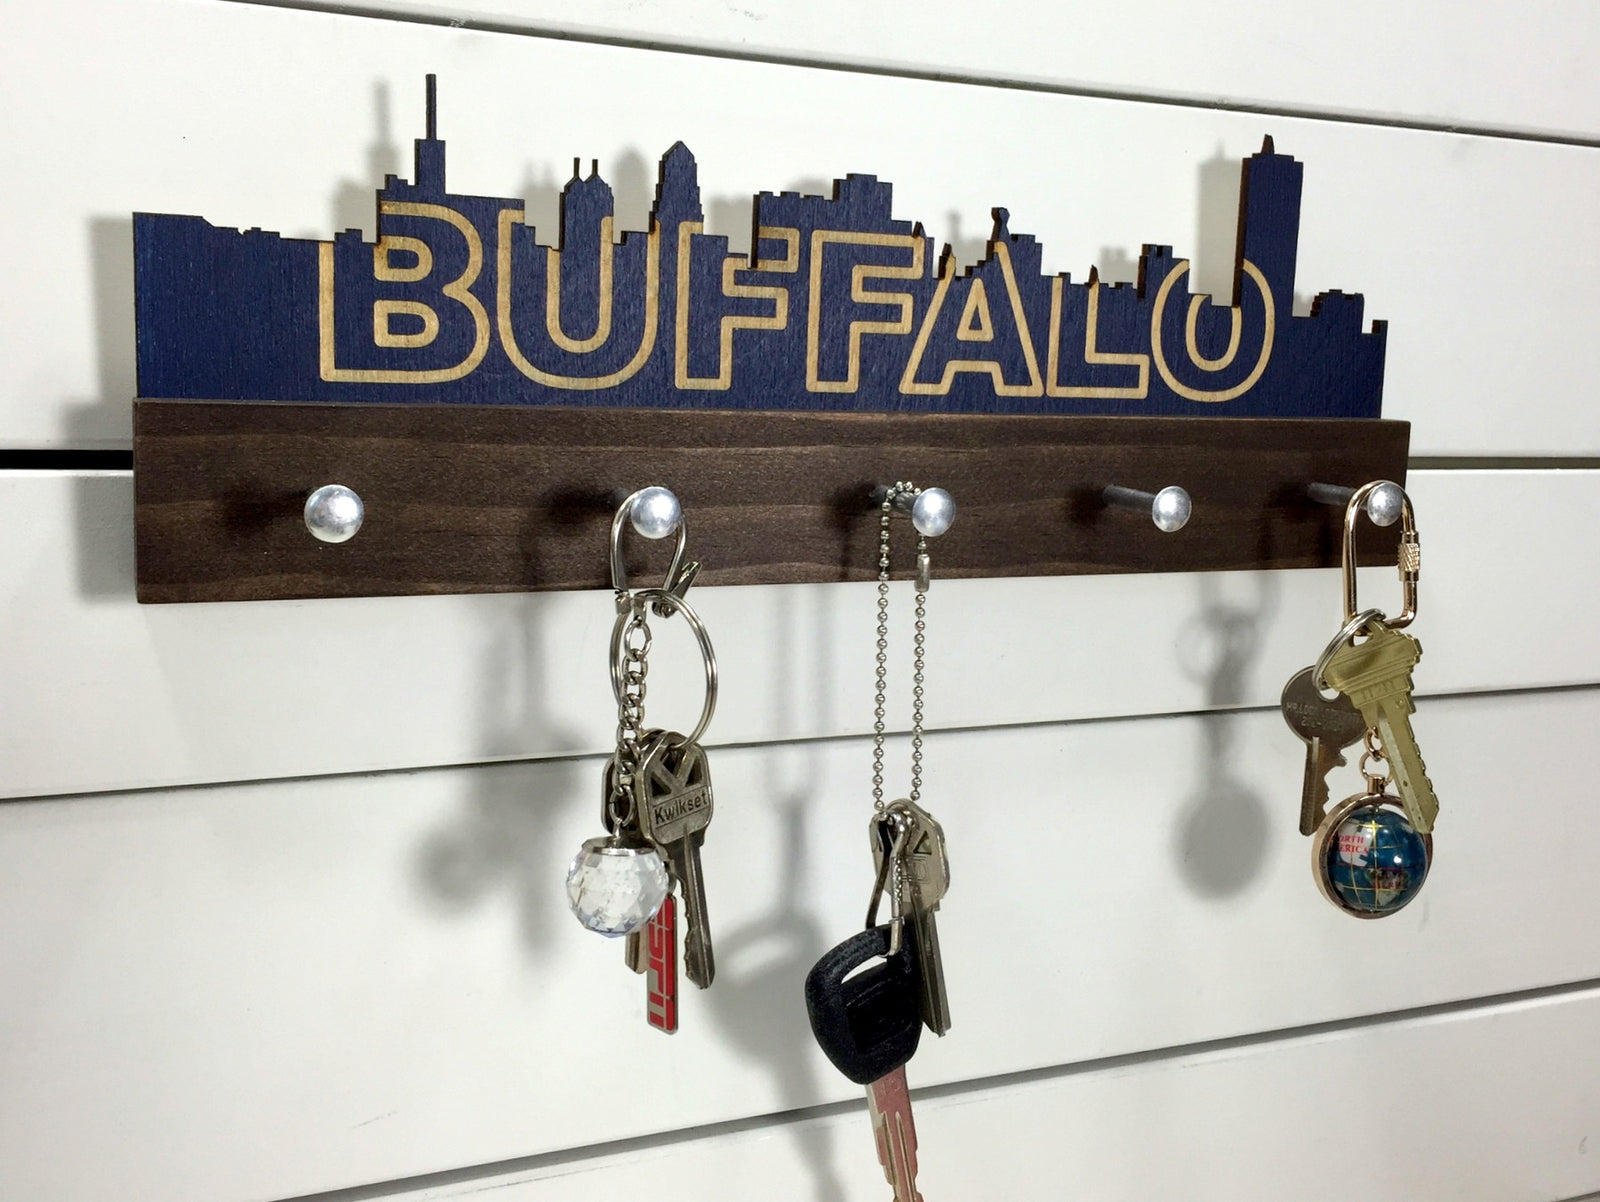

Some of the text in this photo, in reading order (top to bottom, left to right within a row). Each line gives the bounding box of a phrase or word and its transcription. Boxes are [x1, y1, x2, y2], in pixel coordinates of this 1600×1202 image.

[320, 202, 1274, 401] BUFFALO
[654, 791, 708, 825] Kwikset
[1338, 834, 1365, 844] ORTH
[1338, 843, 1369, 854] ERICA
